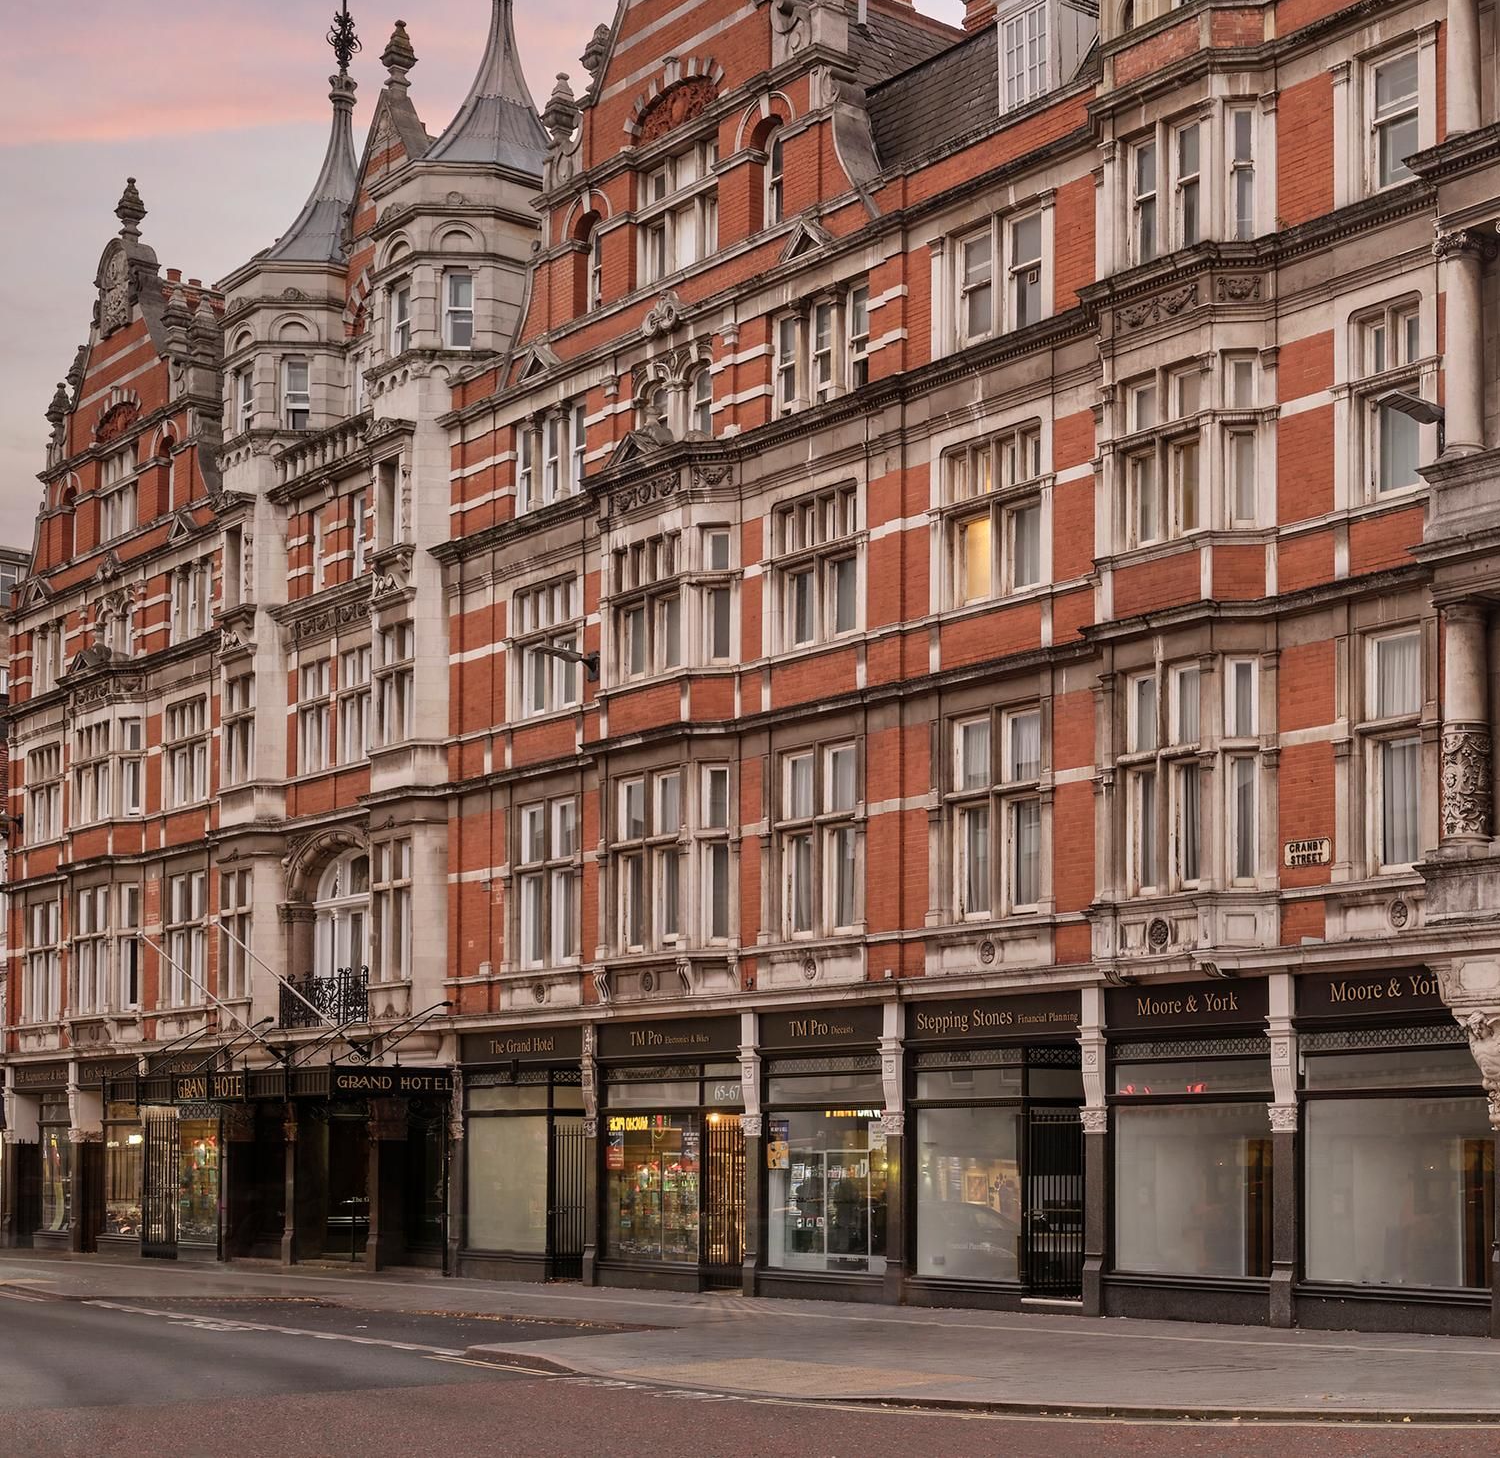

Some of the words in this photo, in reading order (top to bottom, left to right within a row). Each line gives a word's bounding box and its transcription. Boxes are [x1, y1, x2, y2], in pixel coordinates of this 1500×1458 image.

[1290, 852, 1323, 865] STREET
[1330, 981, 1382, 1002] Moore
[1387, 977, 1402, 998] &
[1409, 975, 1438, 996] Yor
[1136, 997, 1182, 1016] Moore
[1186, 995, 1198, 1013] &
[1204, 991, 1239, 1012] York
[789, 1020, 807, 1037] TM
[811, 1019, 828, 1035] Pro
[917, 1010, 970, 1034] Stepping
[972, 1008, 1013, 1027] Stones
[1018, 1012, 1047, 1024] Financial
[1049, 1011, 1079, 1024] Planning
[489, 1039, 505, 1055] The
[506, 1037, 532, 1053] Grand
[533, 1036, 555, 1052] Hotel
[630, 1030, 646, 1047] TM
[648, 1029, 663, 1045] Pro
[177, 1078, 207, 1099] GRAN
[213, 1075, 243, 1097] HOTE
[337, 1075, 393, 1089] GRAND
[400, 1076, 454, 1091] HOTEL
[713, 1084, 741, 1102] 65-67
